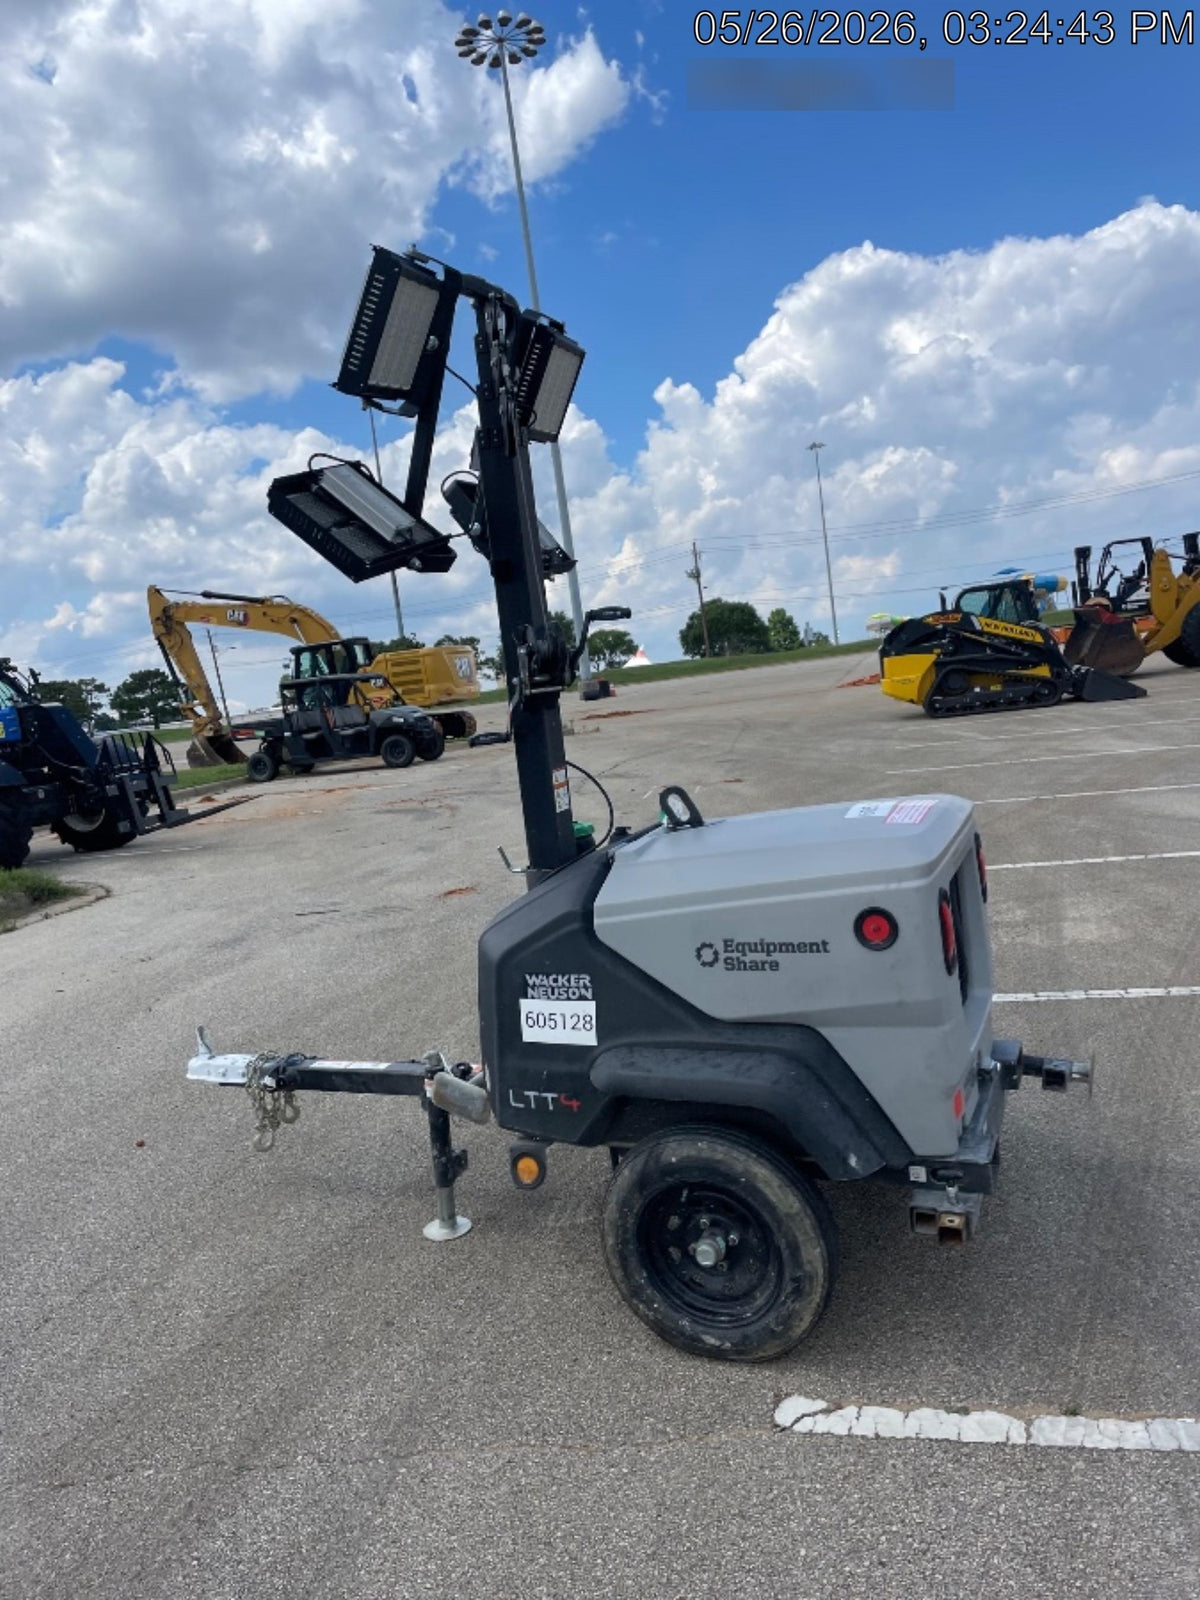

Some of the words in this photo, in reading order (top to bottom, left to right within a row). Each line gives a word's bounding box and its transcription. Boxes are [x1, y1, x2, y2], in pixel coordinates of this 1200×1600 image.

[227, 609, 244, 622] CAT
[723, 938, 830, 955] Equipment
[723, 956, 780, 972] Share
[525, 973, 591, 987] WACKER
[527, 986, 593, 1000] NEUSON
[525, 1011, 594, 1032] 605128
[509, 1088, 582, 1113] LTT4
